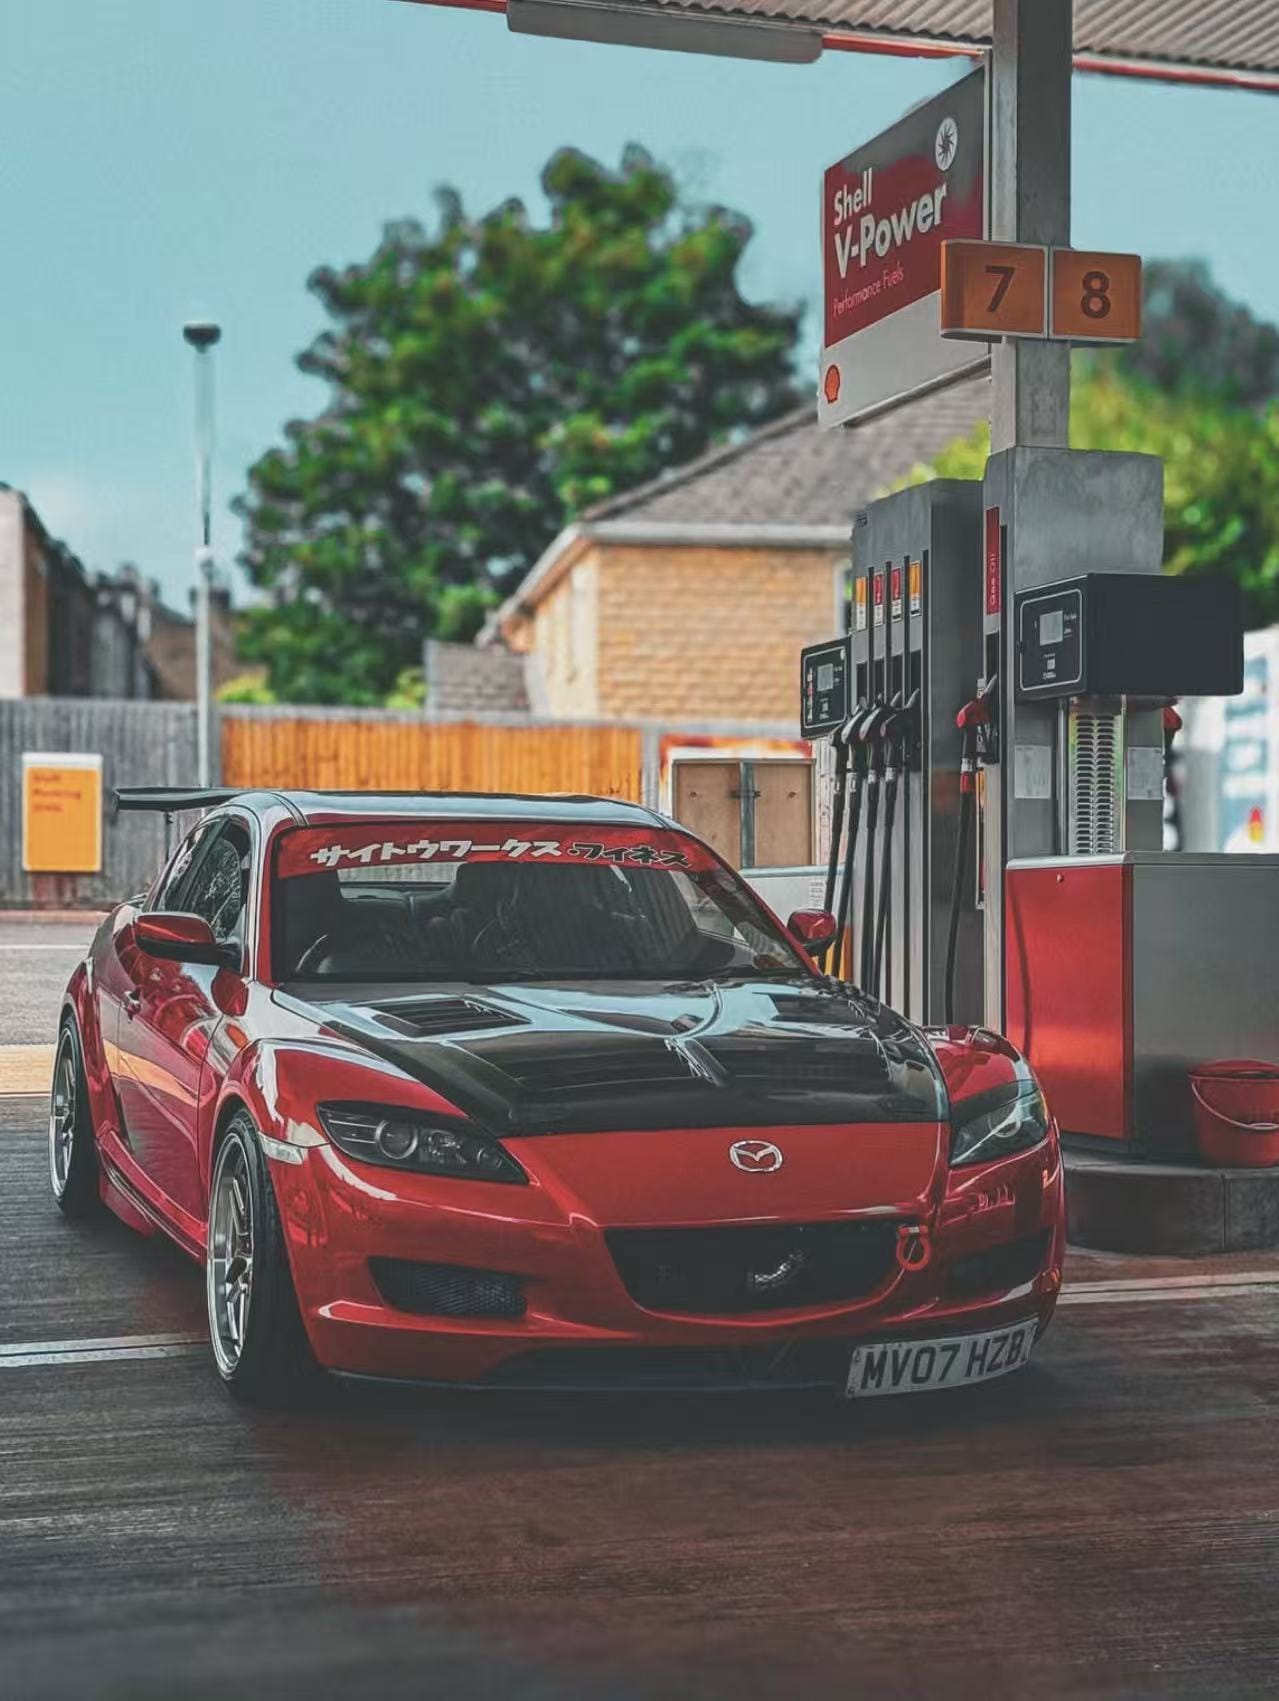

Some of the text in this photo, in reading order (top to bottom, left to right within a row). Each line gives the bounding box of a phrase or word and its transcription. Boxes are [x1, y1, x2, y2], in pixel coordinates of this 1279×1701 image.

[834, 168, 872, 225] Shell
[834, 183, 947, 279] V-Power
[833, 259, 904, 317] Performance Fuels
[985, 264, 1016, 313] 7
[1080, 271, 1111, 319] 8
[965, 1329, 1026, 1377] HZB
